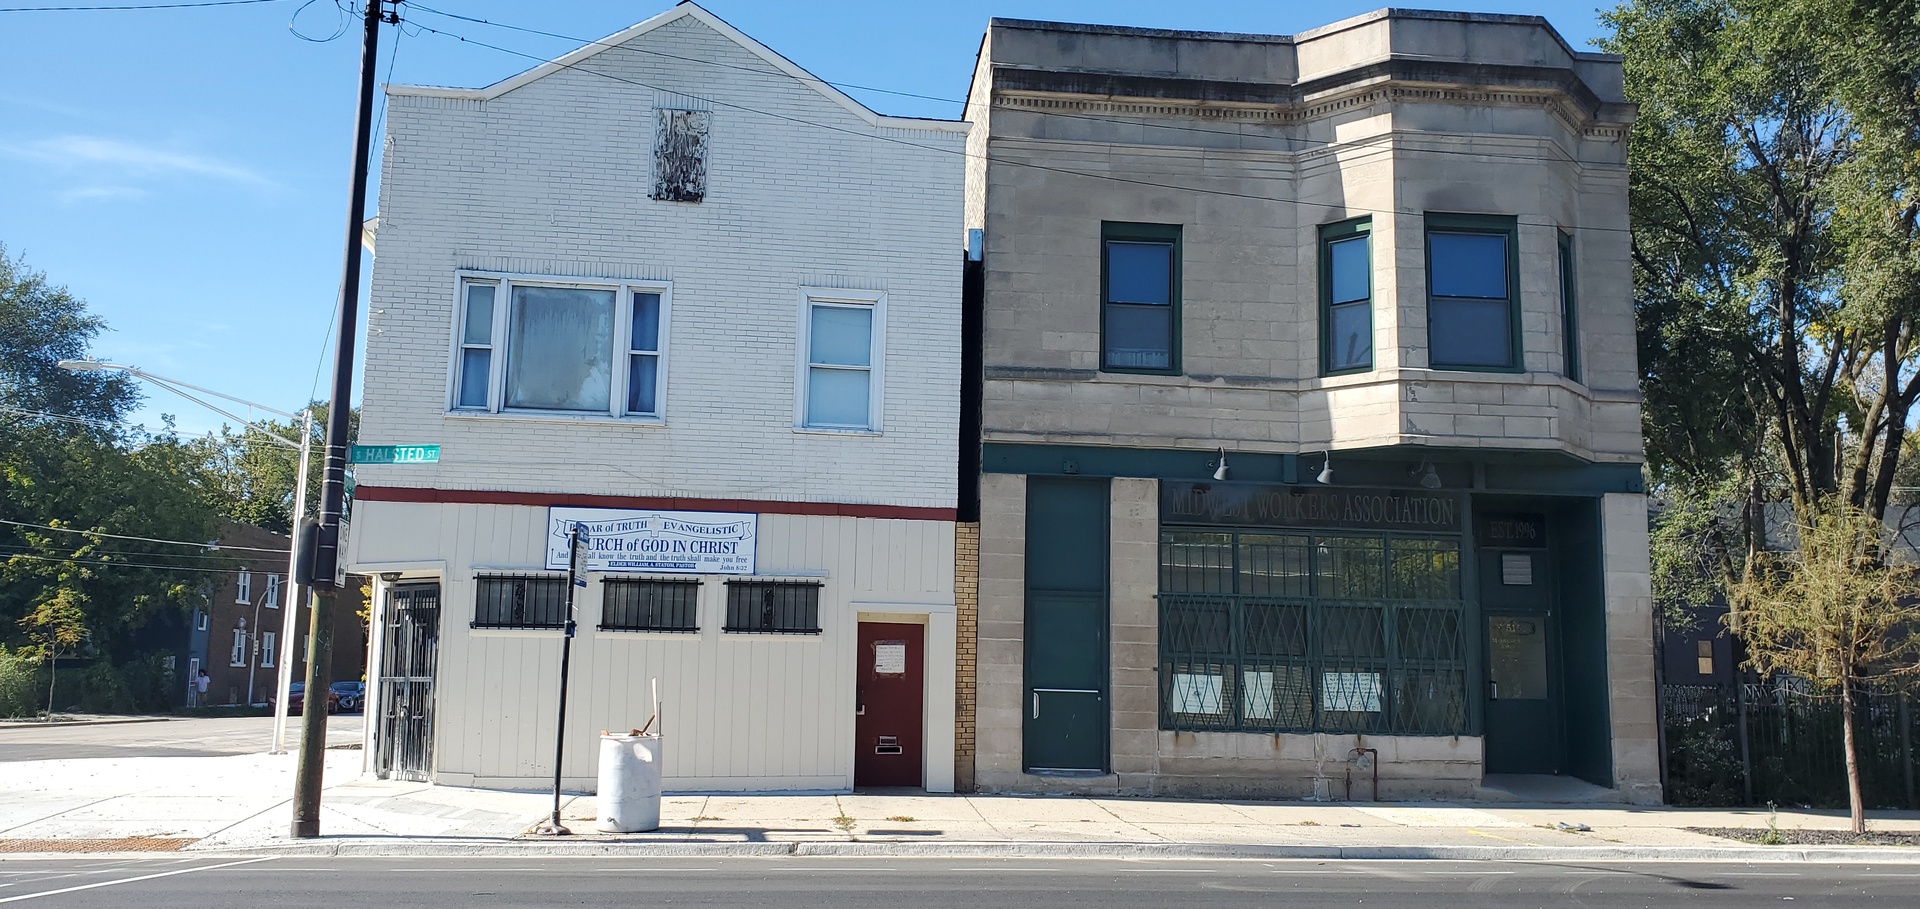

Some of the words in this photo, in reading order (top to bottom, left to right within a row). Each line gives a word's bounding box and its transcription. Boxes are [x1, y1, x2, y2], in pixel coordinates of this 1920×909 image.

[356, 450, 361, 459] S
[365, 447, 425, 462] HALSTED
[427, 449, 436, 458] ST
[1257, 491, 1339, 521] WORKERS
[1342, 493, 1454, 525] ASSOCIATION
[569, 523, 603, 533] PAR
[605, 522, 614, 532] of
[616, 520, 648, 532] TRUTH
[663, 521, 739, 534] EVANGELISTIC
[567, 538, 623, 551] URCH
[626, 538, 639, 552] of
[640, 538, 670, 553] GOD
[672, 540, 688, 553] IN
[690, 540, 739, 554] CHRIST
[556, 551, 569, 559] And
[598, 552, 614, 560] know
[617, 552, 627, 560] the
[629, 553, 645, 561] truth
[646, 553, 657, 561] and
[671, 554, 686, 562] truth
[687, 554, 702, 562] shall
[704, 555, 720, 563] make
[722, 557, 733, 565] you
[735, 556, 748, 564] free
